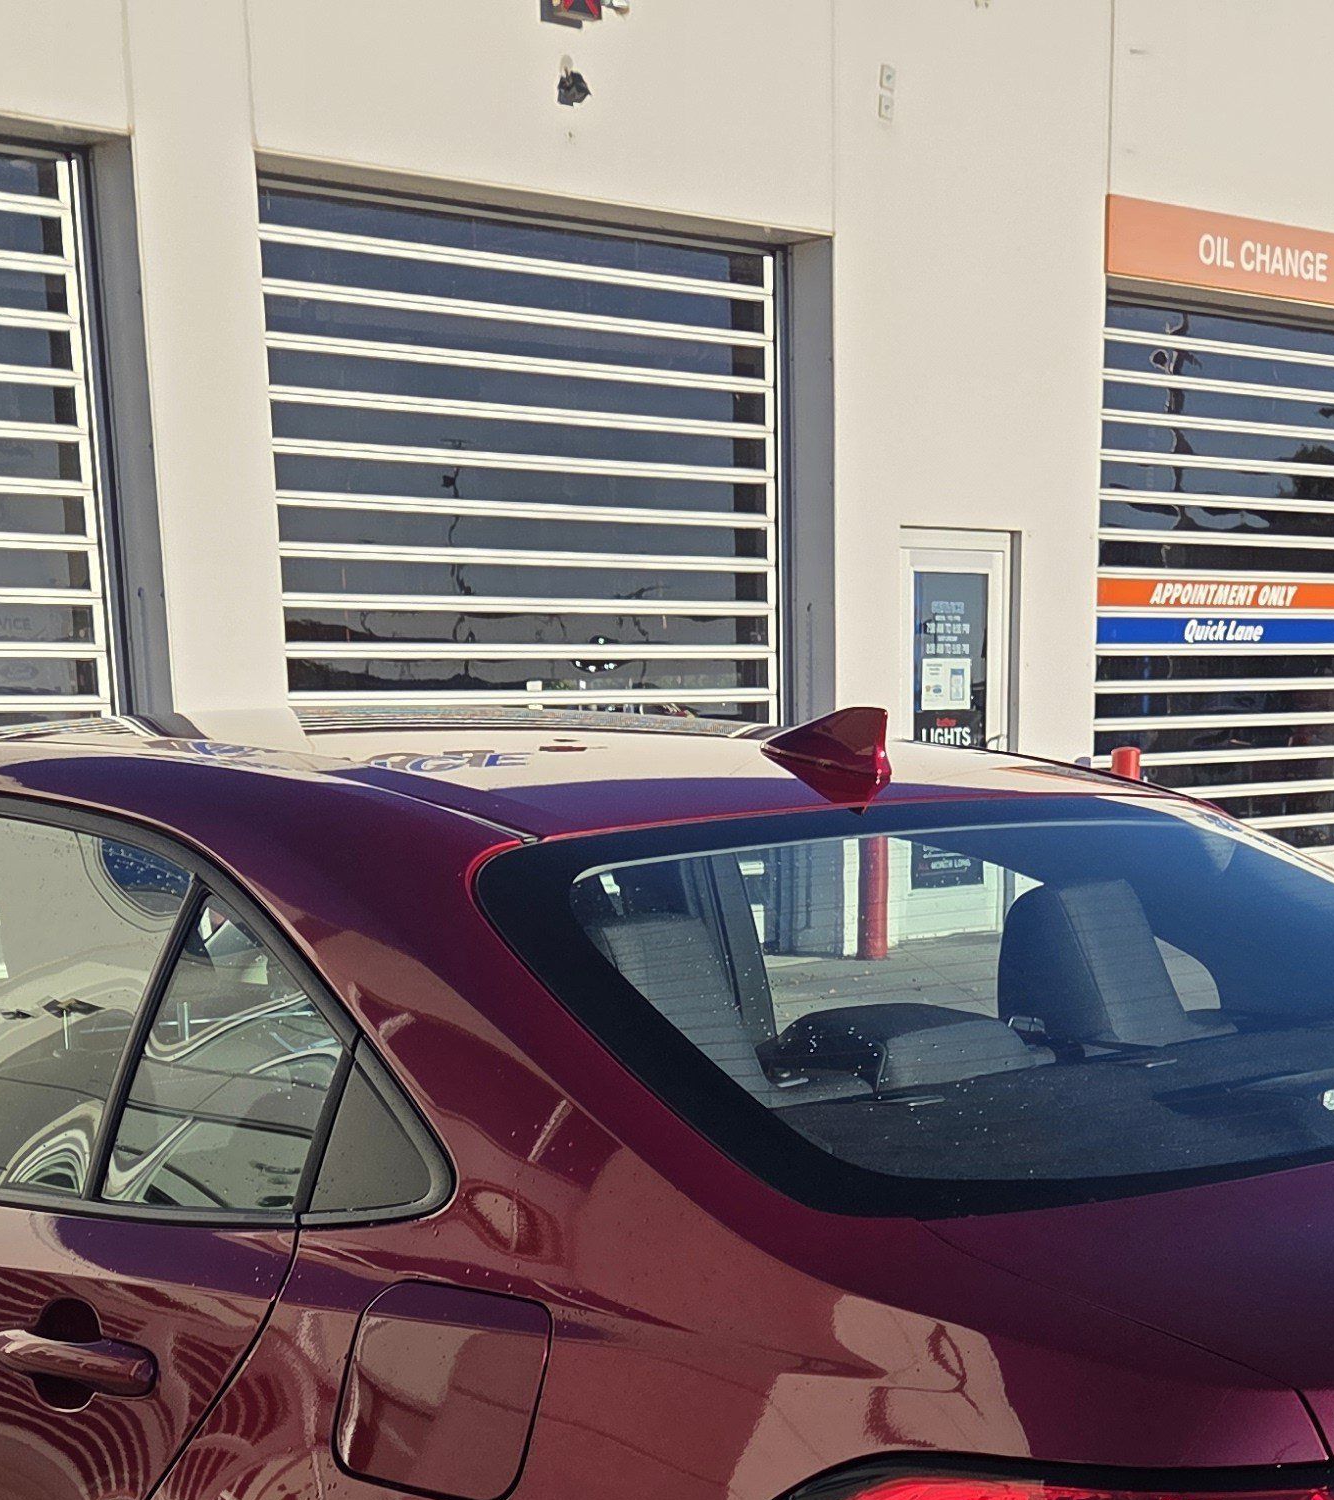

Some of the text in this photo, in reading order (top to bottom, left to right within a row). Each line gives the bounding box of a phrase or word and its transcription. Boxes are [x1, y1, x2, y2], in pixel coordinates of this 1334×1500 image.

[1197, 232, 1329, 283] OIL CHANGE
[1149, 582, 1298, 607] APPOINTMENT ONLY
[1184, 618, 1264, 643] Quick Lane
